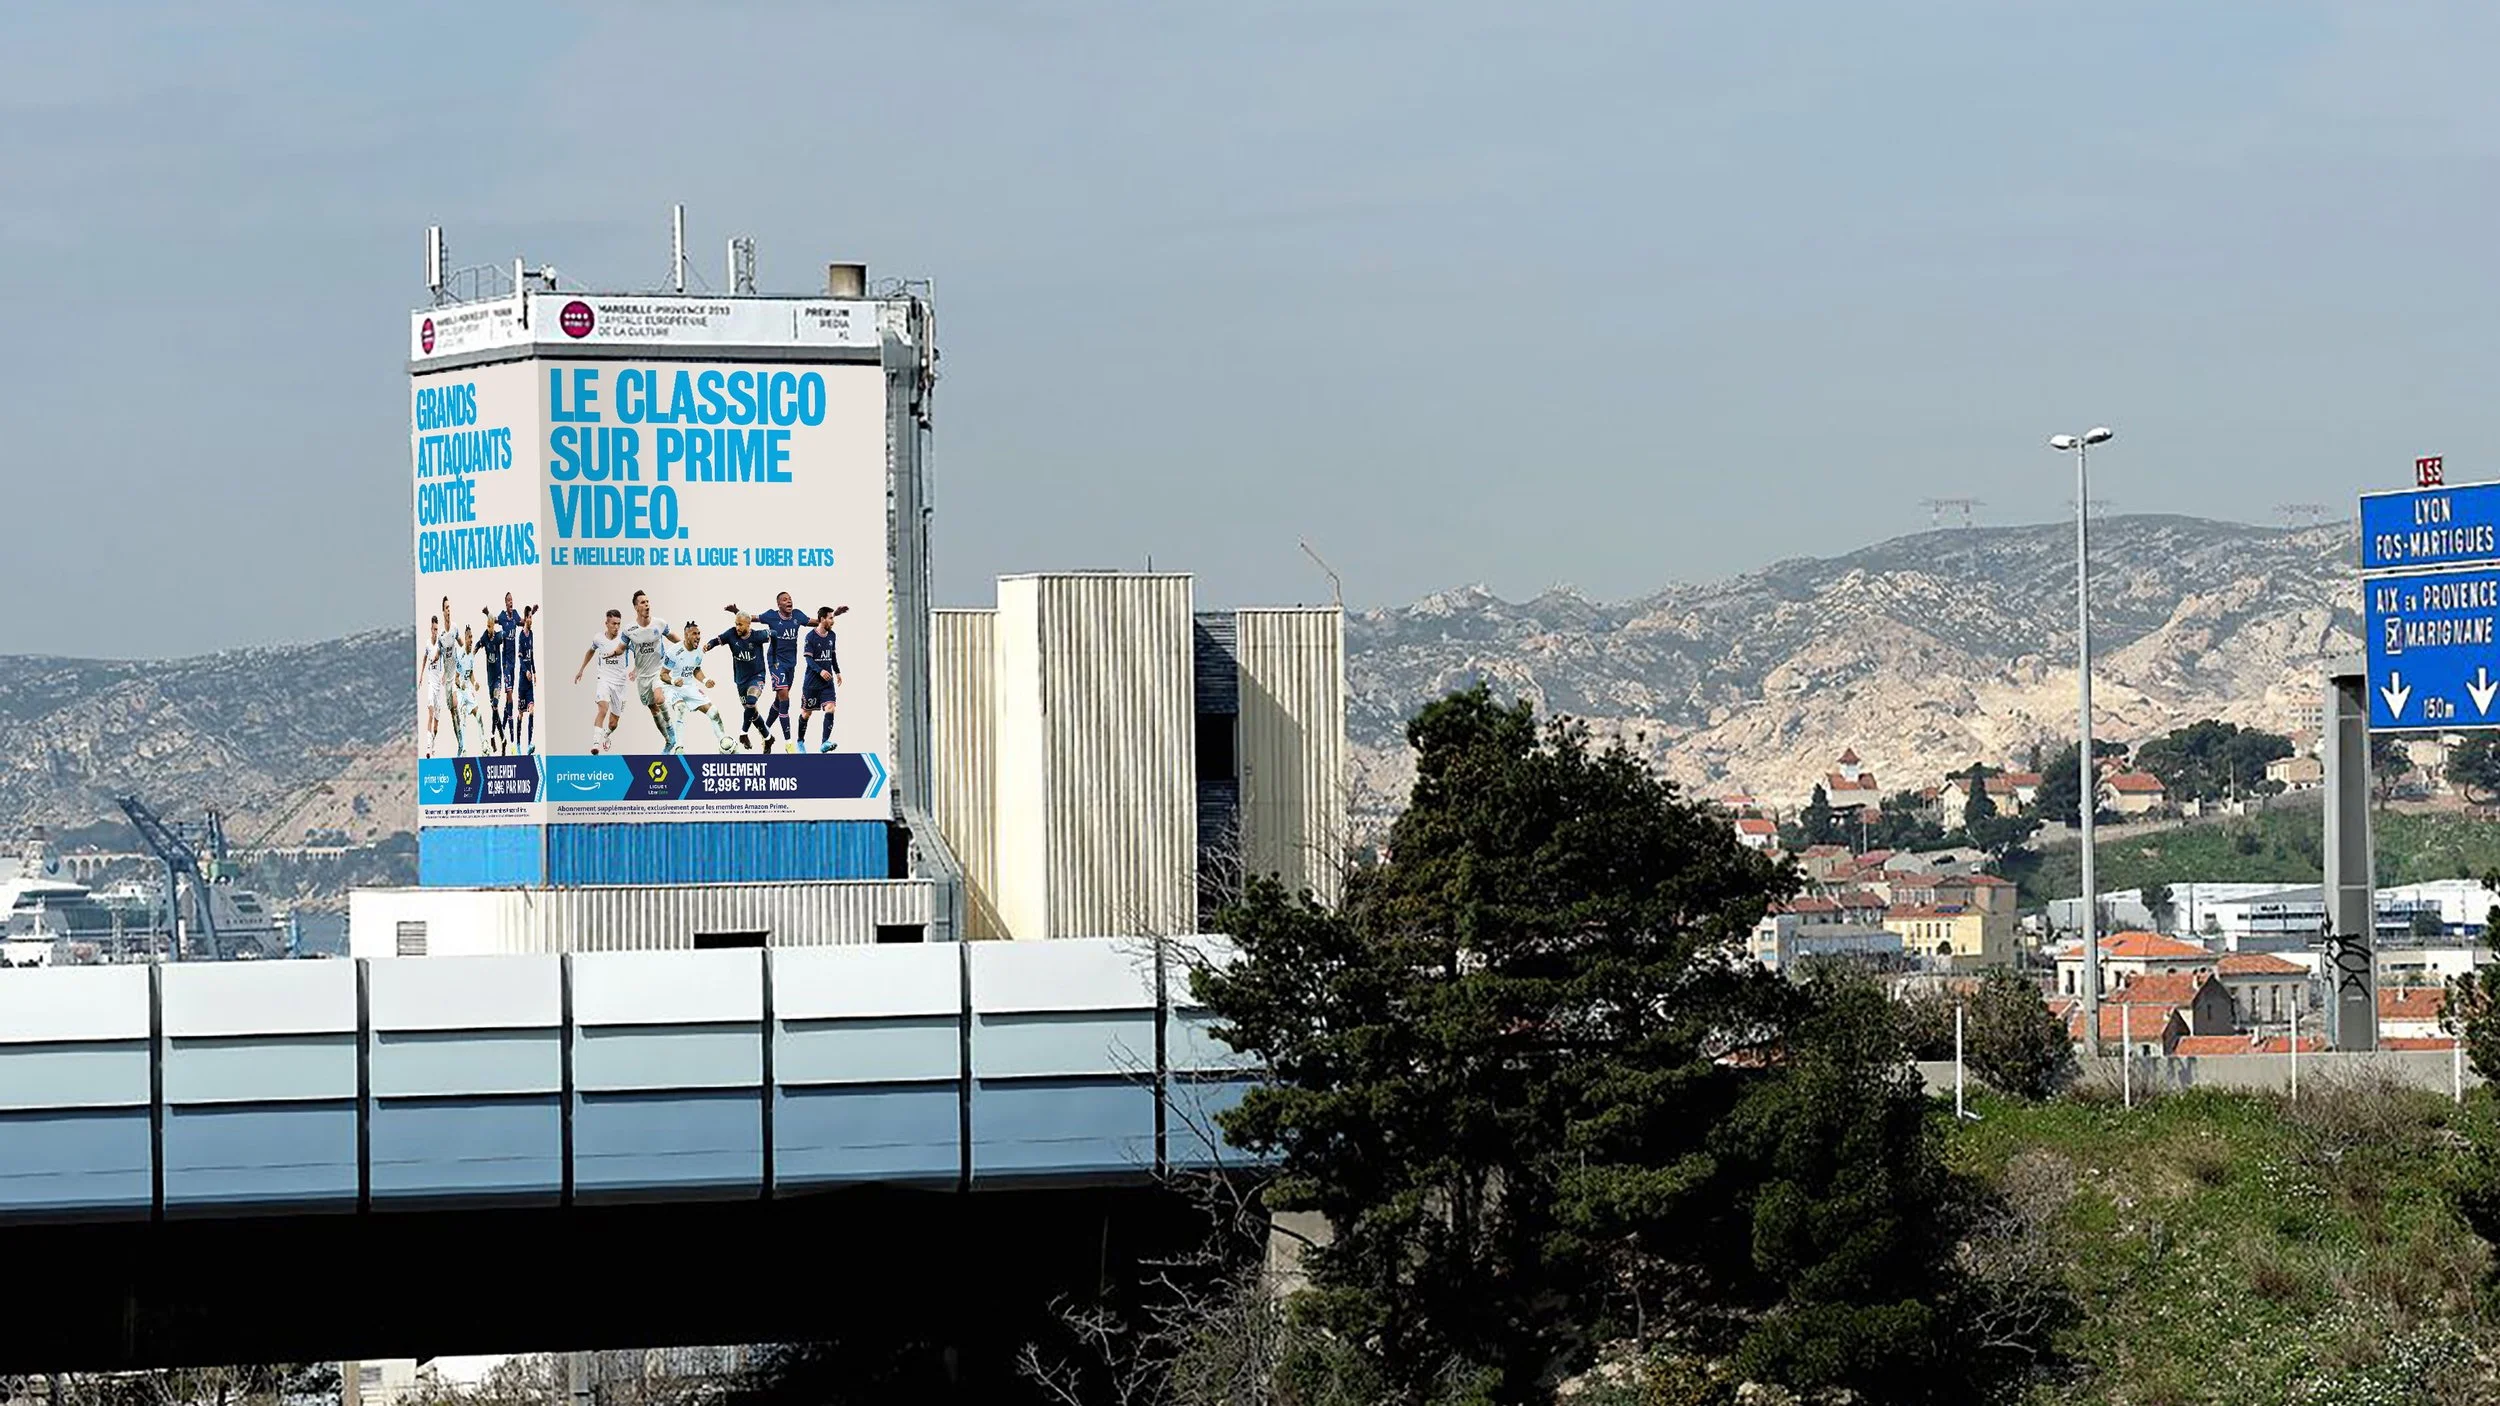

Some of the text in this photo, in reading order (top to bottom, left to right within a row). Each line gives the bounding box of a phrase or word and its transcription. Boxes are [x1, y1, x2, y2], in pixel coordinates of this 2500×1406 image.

[805, 307, 850, 317] PREMIUM
[416, 382, 477, 431] GRANDS
[550, 368, 826, 426] LE CLASSICO
[417, 426, 512, 480] ATTAQUANTS
[550, 426, 792, 483] SUR PRIME
[418, 479, 476, 526] CONTRE
[550, 484, 689, 540] VIDEO.
[2416, 499, 2451, 525] LYON
[418, 521, 540, 574] GRANTATAKANS.
[551, 547, 834, 567] LE MEILLEUR DE LA LIGUE 1 UBER EATS
[2377, 526, 2494, 560] FOS-MARTIGUES
[2377, 588, 2398, 613] AIX
[2424, 581, 2497, 610] PROVENCE
[2405, 617, 2493, 647] MARIGNANE
[487, 765, 517, 779] SEULEMENT
[557, 771, 614, 783] prime video
[702, 763, 767, 777] SEULEMENT
[506, 780, 517, 794] PAR
[517, 780, 531, 793] MOIS
[702, 777, 797, 794] 12,99€ PAR MOIS
[597, 804, 646, 813] supplémentaire,
